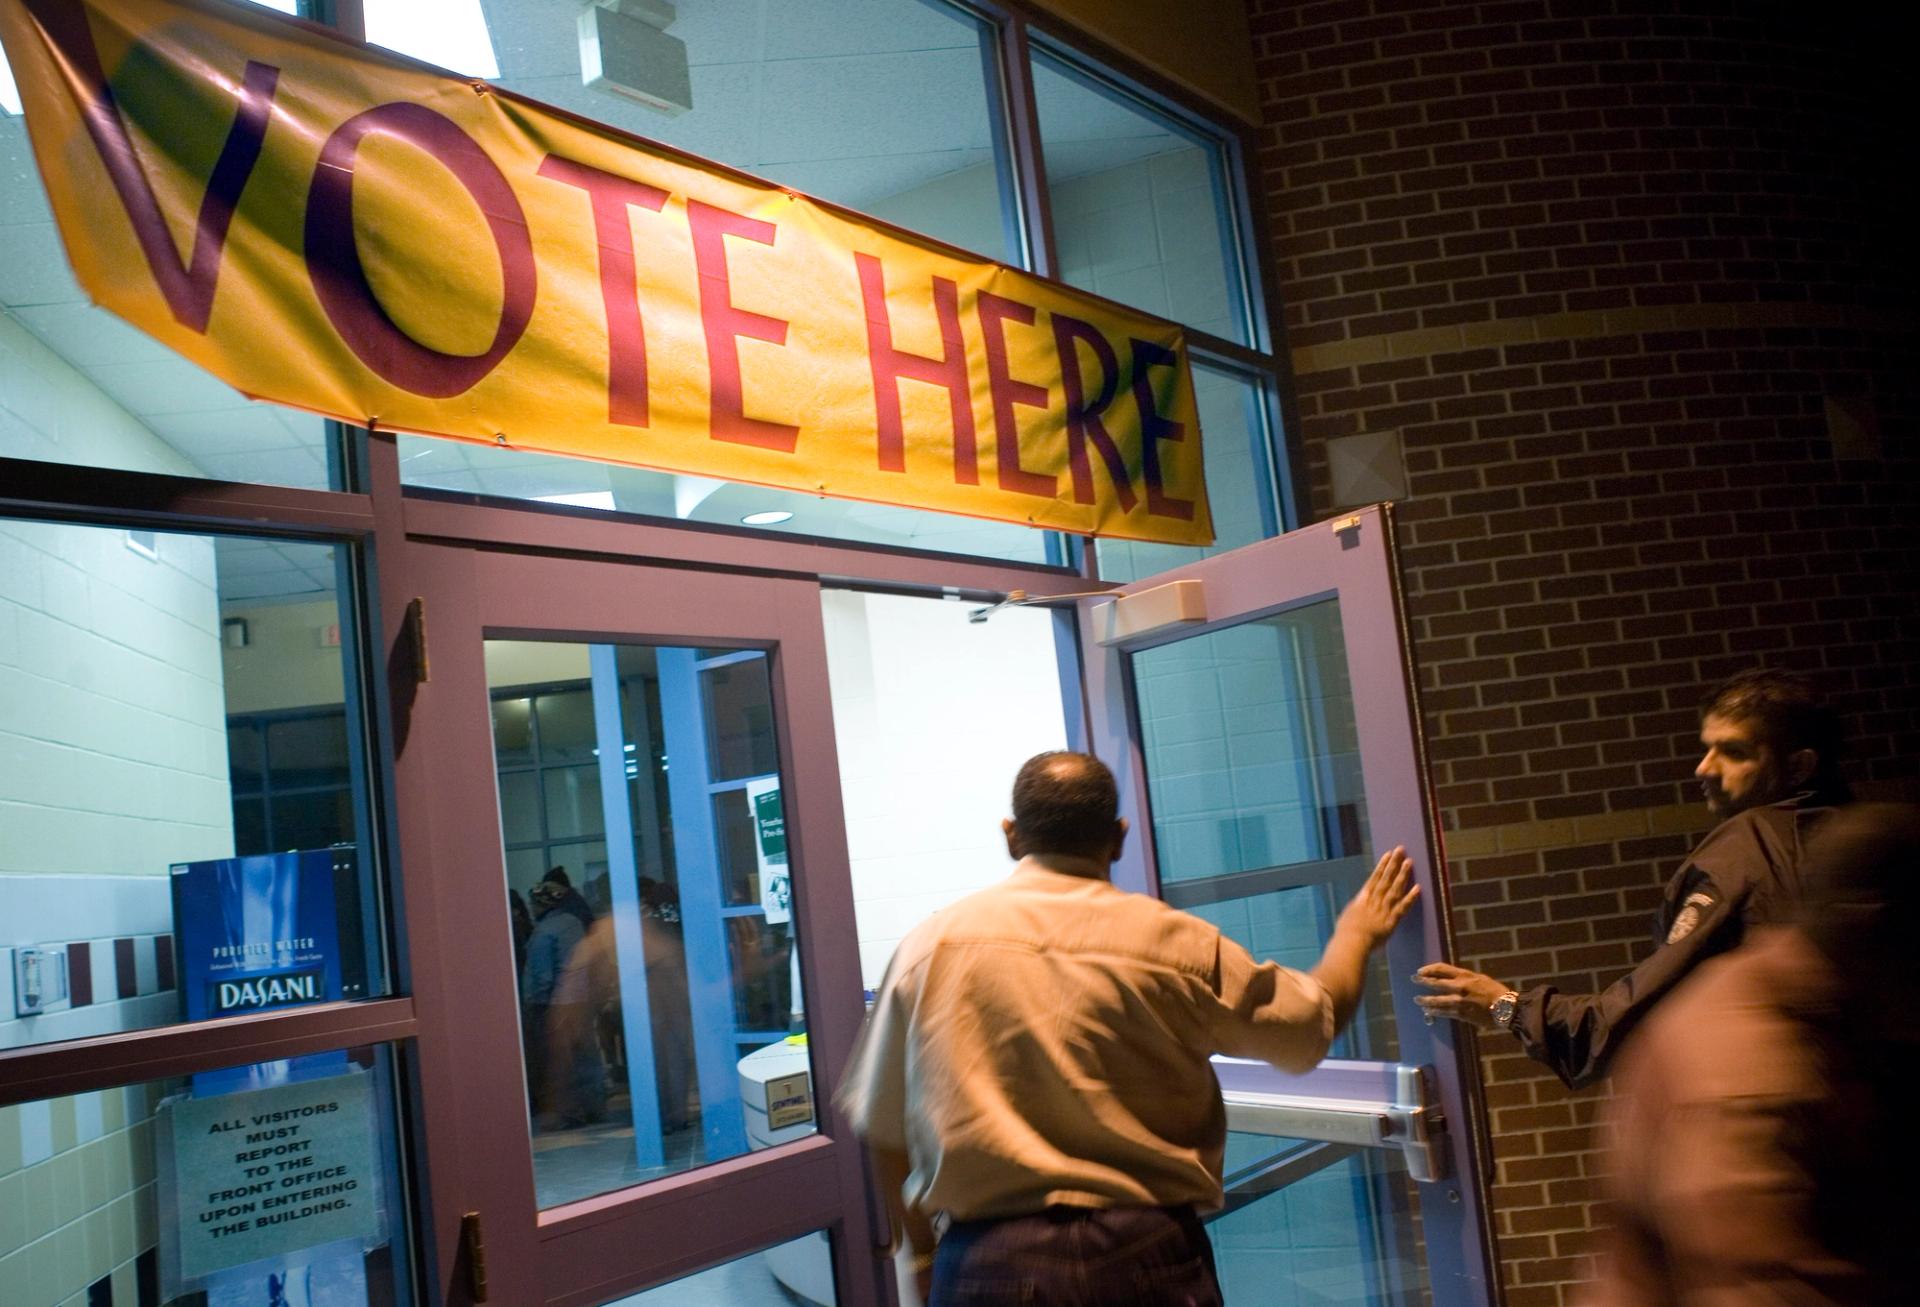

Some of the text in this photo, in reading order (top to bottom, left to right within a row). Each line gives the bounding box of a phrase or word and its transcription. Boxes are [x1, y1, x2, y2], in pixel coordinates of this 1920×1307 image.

[26, 0, 1194, 522] VOTE HERE
[213, 938, 314, 958] PURIFIED WATER
[220, 975, 315, 1009] DASANI
[208, 1101, 339, 1135] ALL VISITORS
[246, 1125, 300, 1145] MUST
[235, 1139, 313, 1164] REPORT
[243, 1155, 314, 1179] TO THE
[199, 1179, 359, 1224] UPON ENTERING
[208, 1165, 348, 1204] FRONT OFFICE
[208, 1199, 353, 1239] THE BUILDING.
